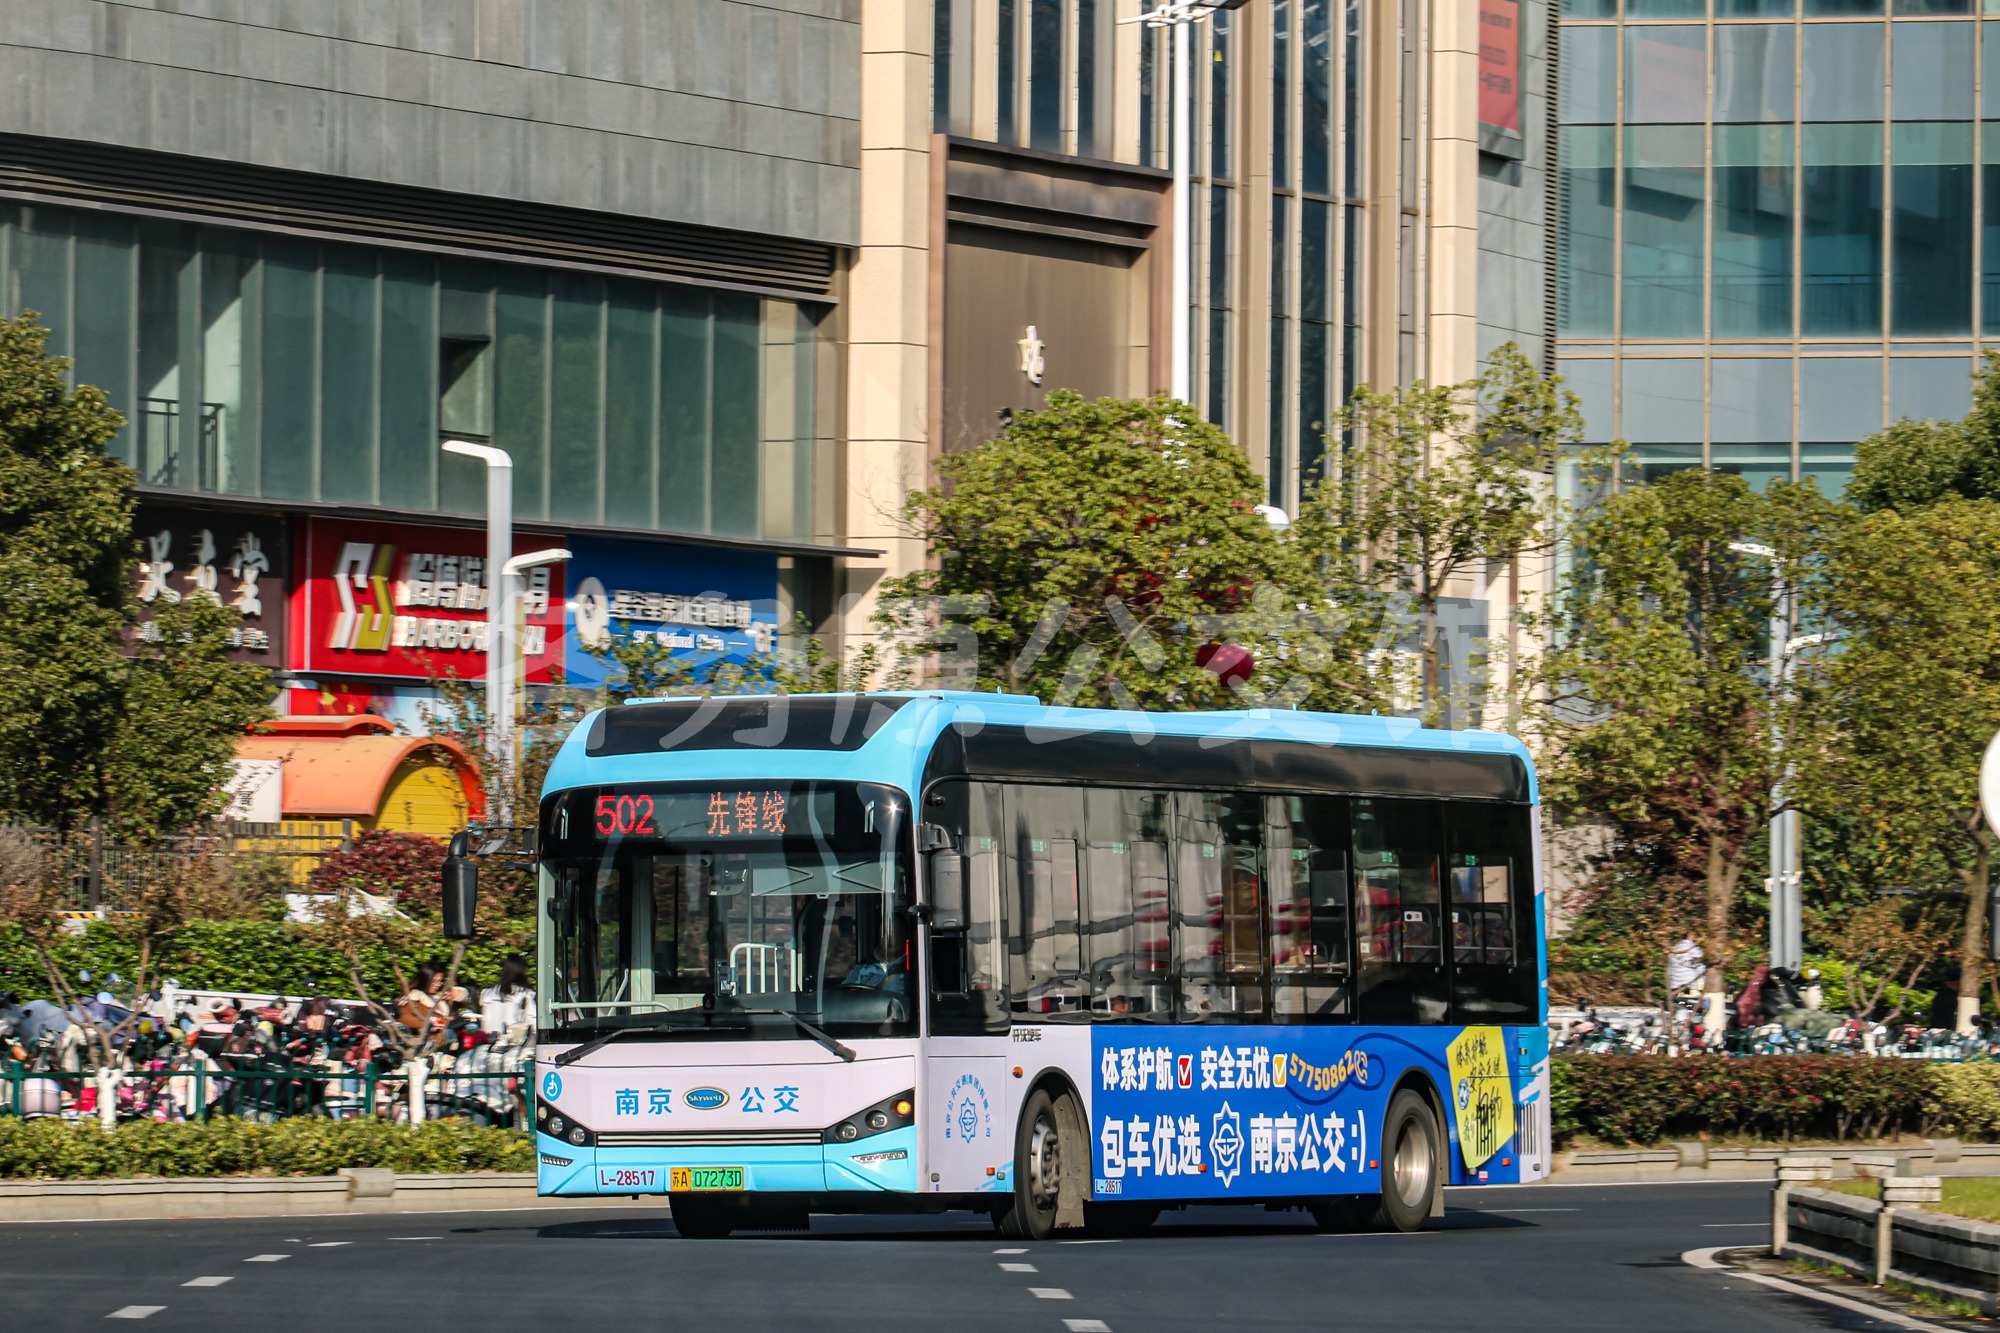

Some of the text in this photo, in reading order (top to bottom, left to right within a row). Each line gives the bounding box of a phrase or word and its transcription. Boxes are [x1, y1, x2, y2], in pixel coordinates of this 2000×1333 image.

[596, 790, 786, 836] 502 先锋线
[1101, 1045, 1270, 1092] 体系护航 安全无忧
[1289, 1050, 1354, 1092] 57750862
[615, 1085, 800, 1116] 南京 公交
[1101, 1114, 1202, 1178] 包车优选
[600, 1169, 655, 1187] L-28517
